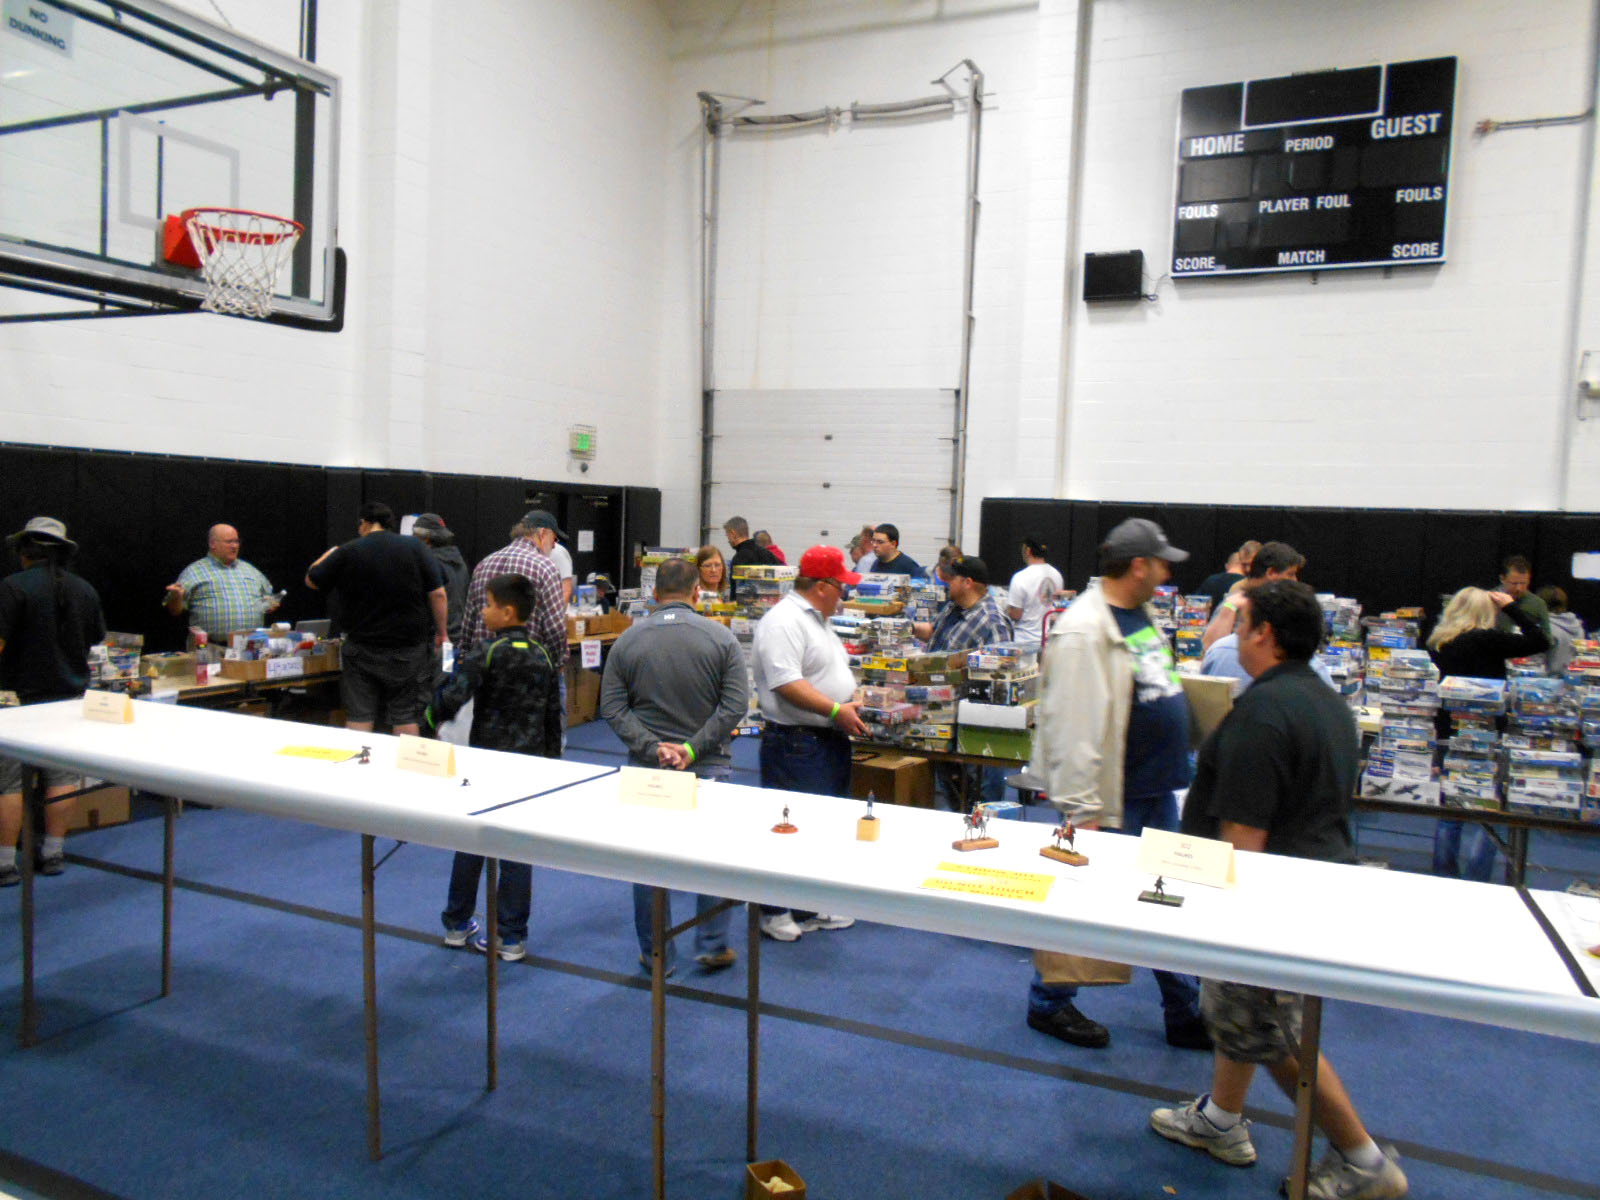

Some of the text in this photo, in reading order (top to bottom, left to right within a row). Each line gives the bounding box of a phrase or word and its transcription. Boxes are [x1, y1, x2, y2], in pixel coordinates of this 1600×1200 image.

[29, 8, 48, 23] NO
[9, 17, 65, 49] DUNKING
[1371, 113, 1442, 140] GUEST
[1190, 134, 1245, 157] HOME
[1284, 136, 1334, 153] PERIOD
[1396, 186, 1443, 203] FOULS
[1178, 204, 1219, 220] FOULS
[1259, 194, 1352, 214] PLAYER FOUL
[1277, 250, 1326, 265] MATCH
[1392, 242, 1440, 258] SCORE
[1175, 256, 1216, 271] SCORE
